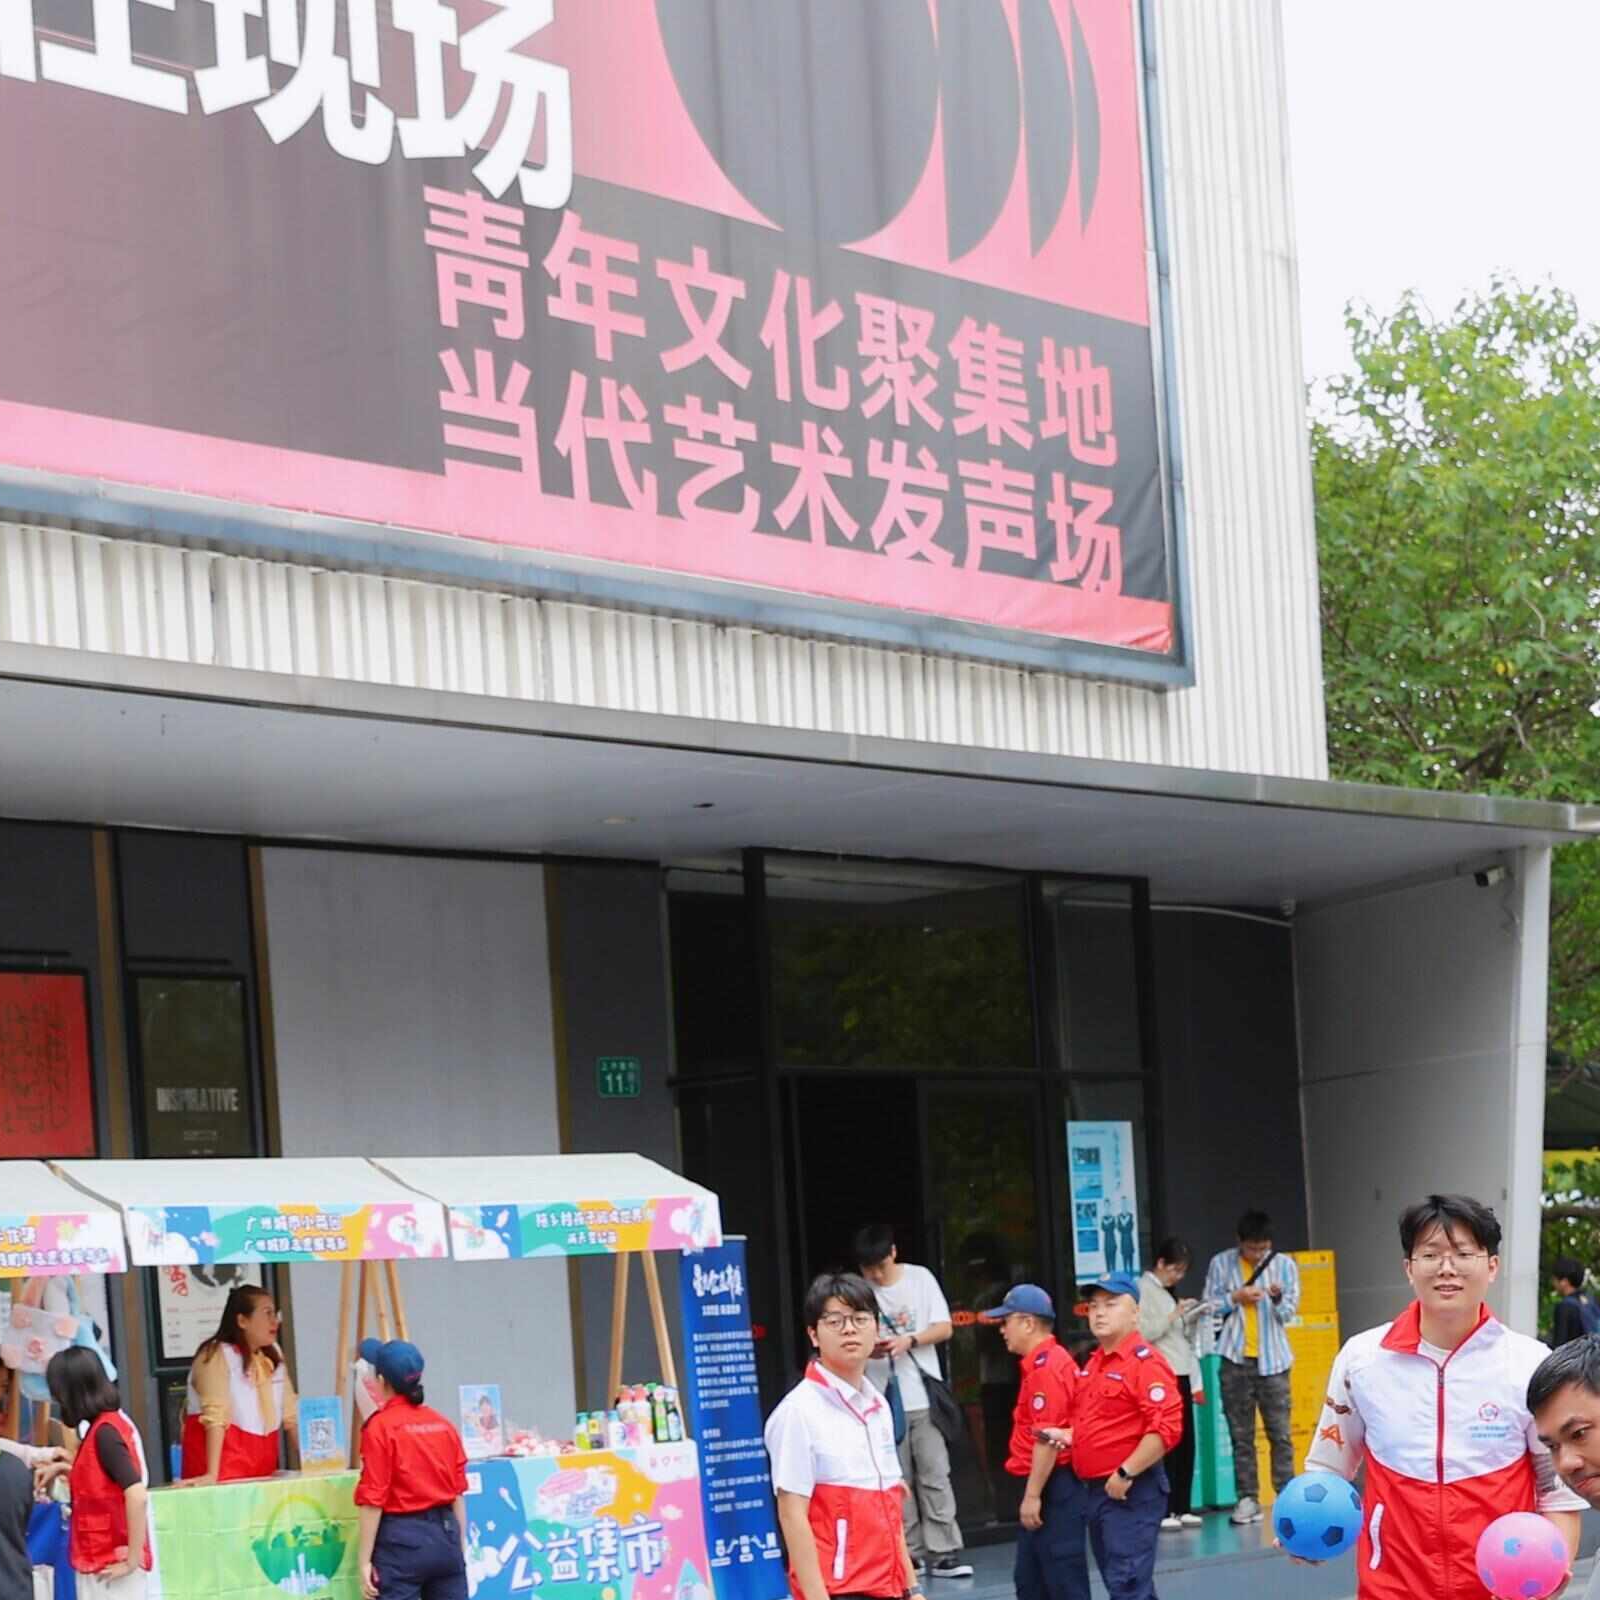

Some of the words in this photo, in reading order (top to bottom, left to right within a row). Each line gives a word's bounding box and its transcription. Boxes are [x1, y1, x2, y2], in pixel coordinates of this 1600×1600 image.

[424, 186, 1116, 468] 青年文化聚集地
[439, 348, 1123, 597] 当代艺术发声场
[499, 1513, 663, 1591] 公益集市
